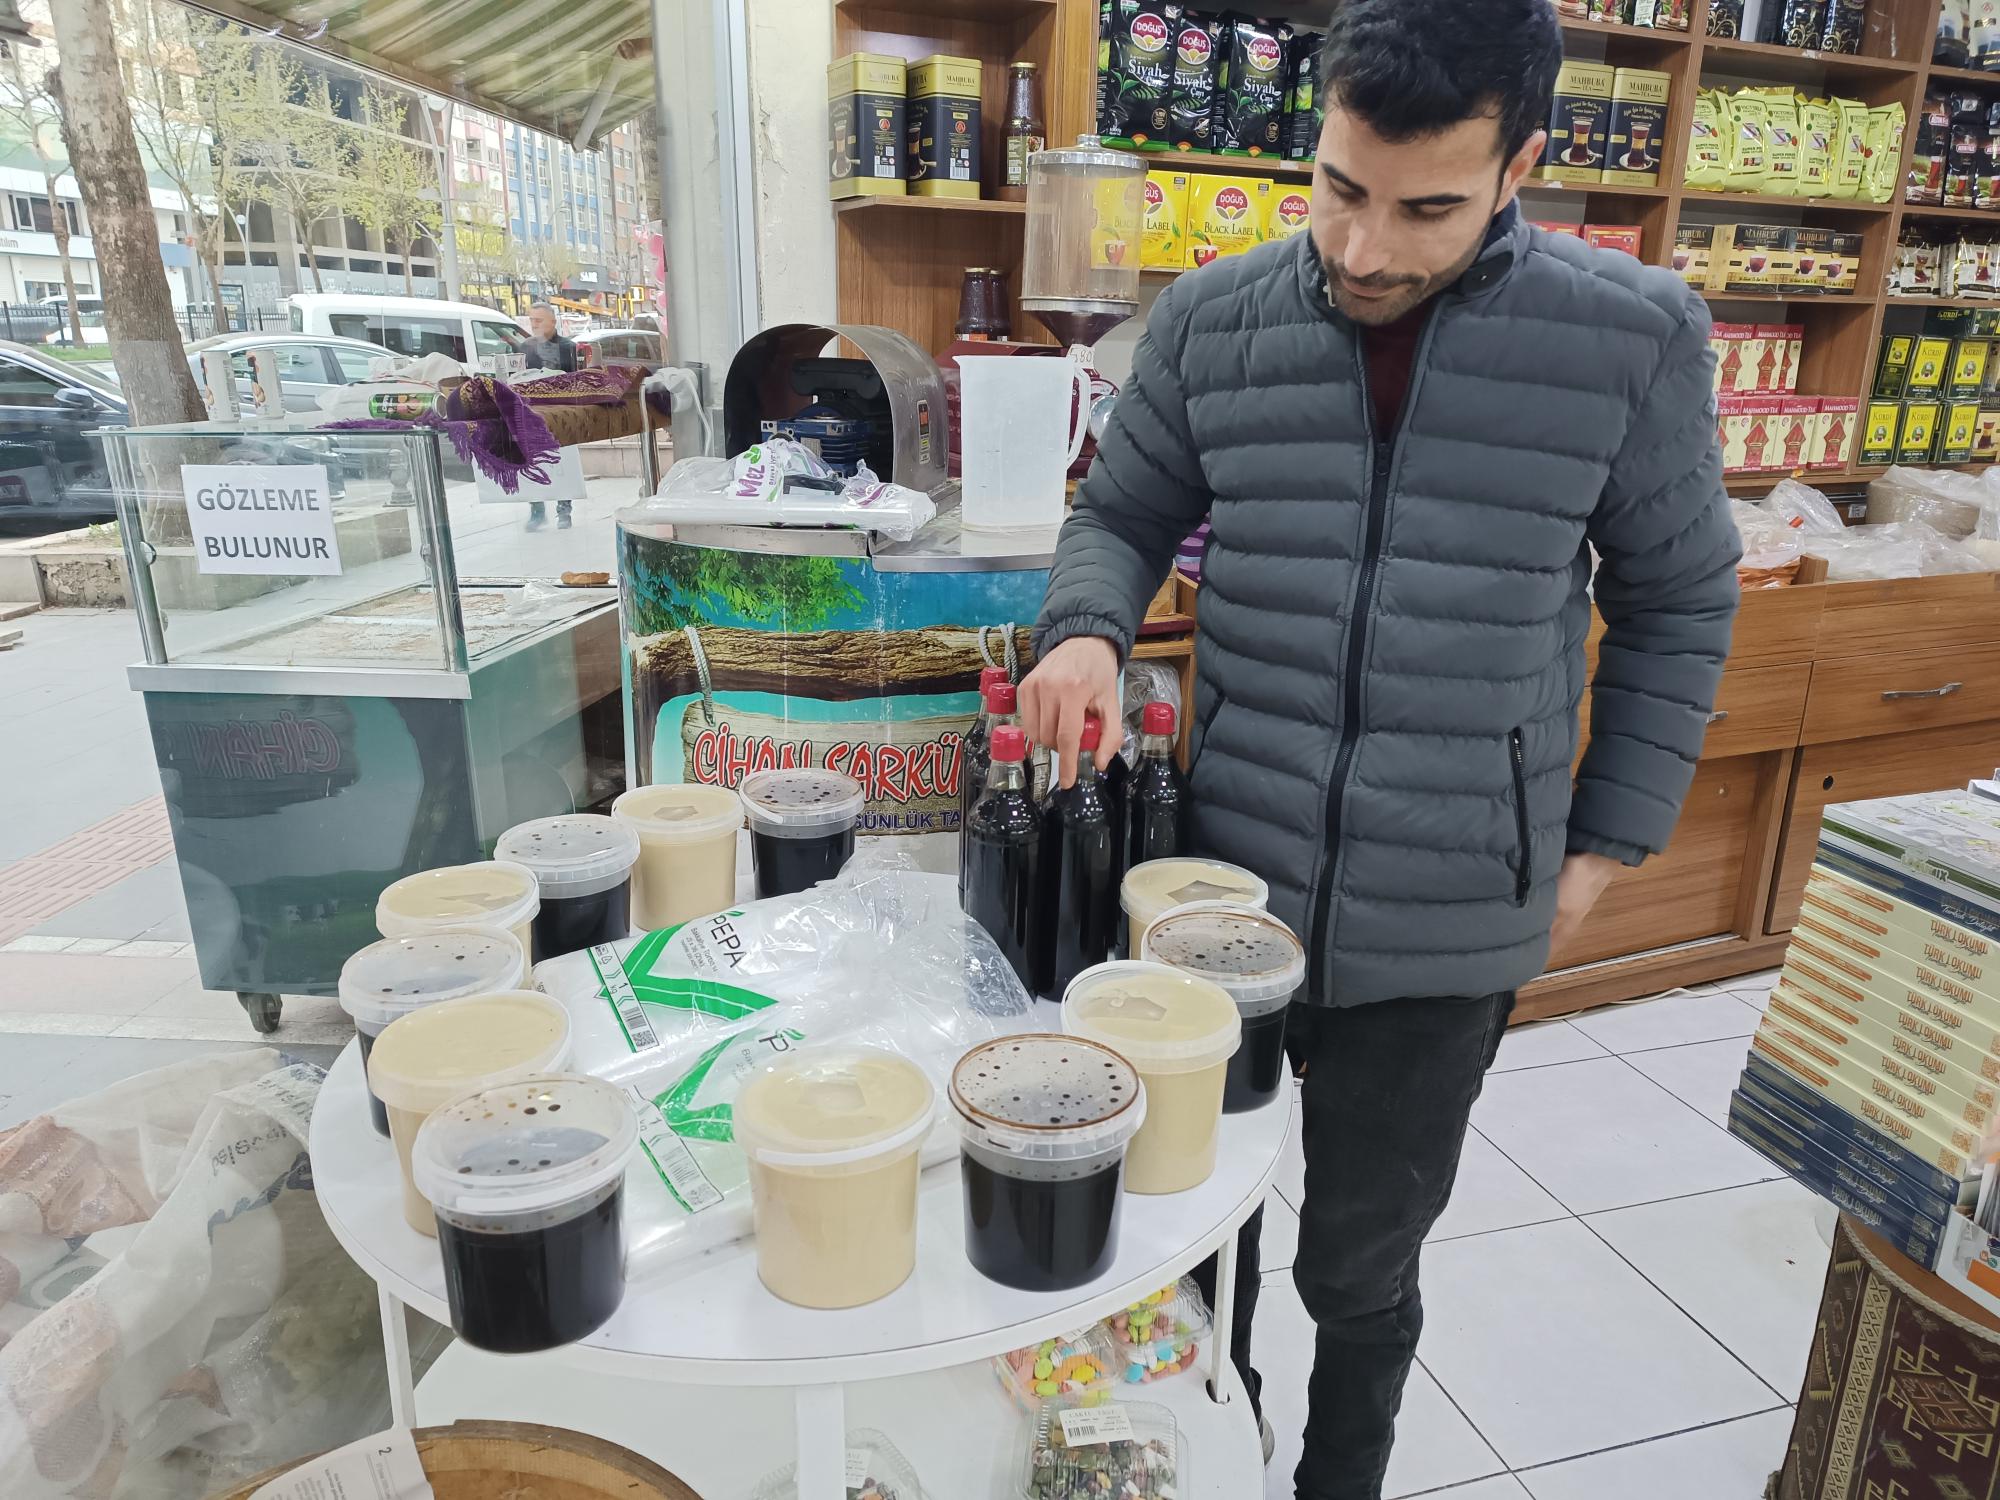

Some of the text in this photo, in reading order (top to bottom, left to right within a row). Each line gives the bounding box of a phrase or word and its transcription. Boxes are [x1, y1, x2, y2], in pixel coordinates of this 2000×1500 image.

[1136, 21, 1162, 36] DOĞUŞ
[1253, 43, 1277, 56] DOĞUŞ
[1128, 59, 1162, 80] Siyah
[1243, 77, 1275, 96] Siyah
[1219, 193, 1244, 205] DOĞUŞ
[1283, 200, 1306, 212] DOĞUŞ
[1147, 218, 1171, 231] LABEL
[1204, 221, 1254, 236] BLACK LABEL
[1677, 229, 1705, 238] AHBUBA
[196, 482, 320, 511] GÖZLEME
[204, 536, 330, 559] BULUNUR
[693, 723, 813, 787] CİHAN
[1930, 919, 1989, 955] TÜRK LOKUMU
[1966, 916, 1999, 932] Delight
[706, 914, 748, 968] PEPA
[1924, 943, 1982, 979] TÜRK LOKUMU
[1916, 966, 1974, 1003] TÜRK LOKUMU
[1907, 990, 1963, 1028] TÜRK LOKUMU
[1898, 1012, 1954, 1049] TÜRK LOKUMU
[1892, 1035, 1947, 1074] TÜRK LOKUMU
[1881, 1055, 1937, 1095] TÜRK LOKUMU
[1872, 1078, 1926, 1118] TÜRK LOKUMU
[1860, 1099, 1913, 1140] TÜRK LOKUMU
